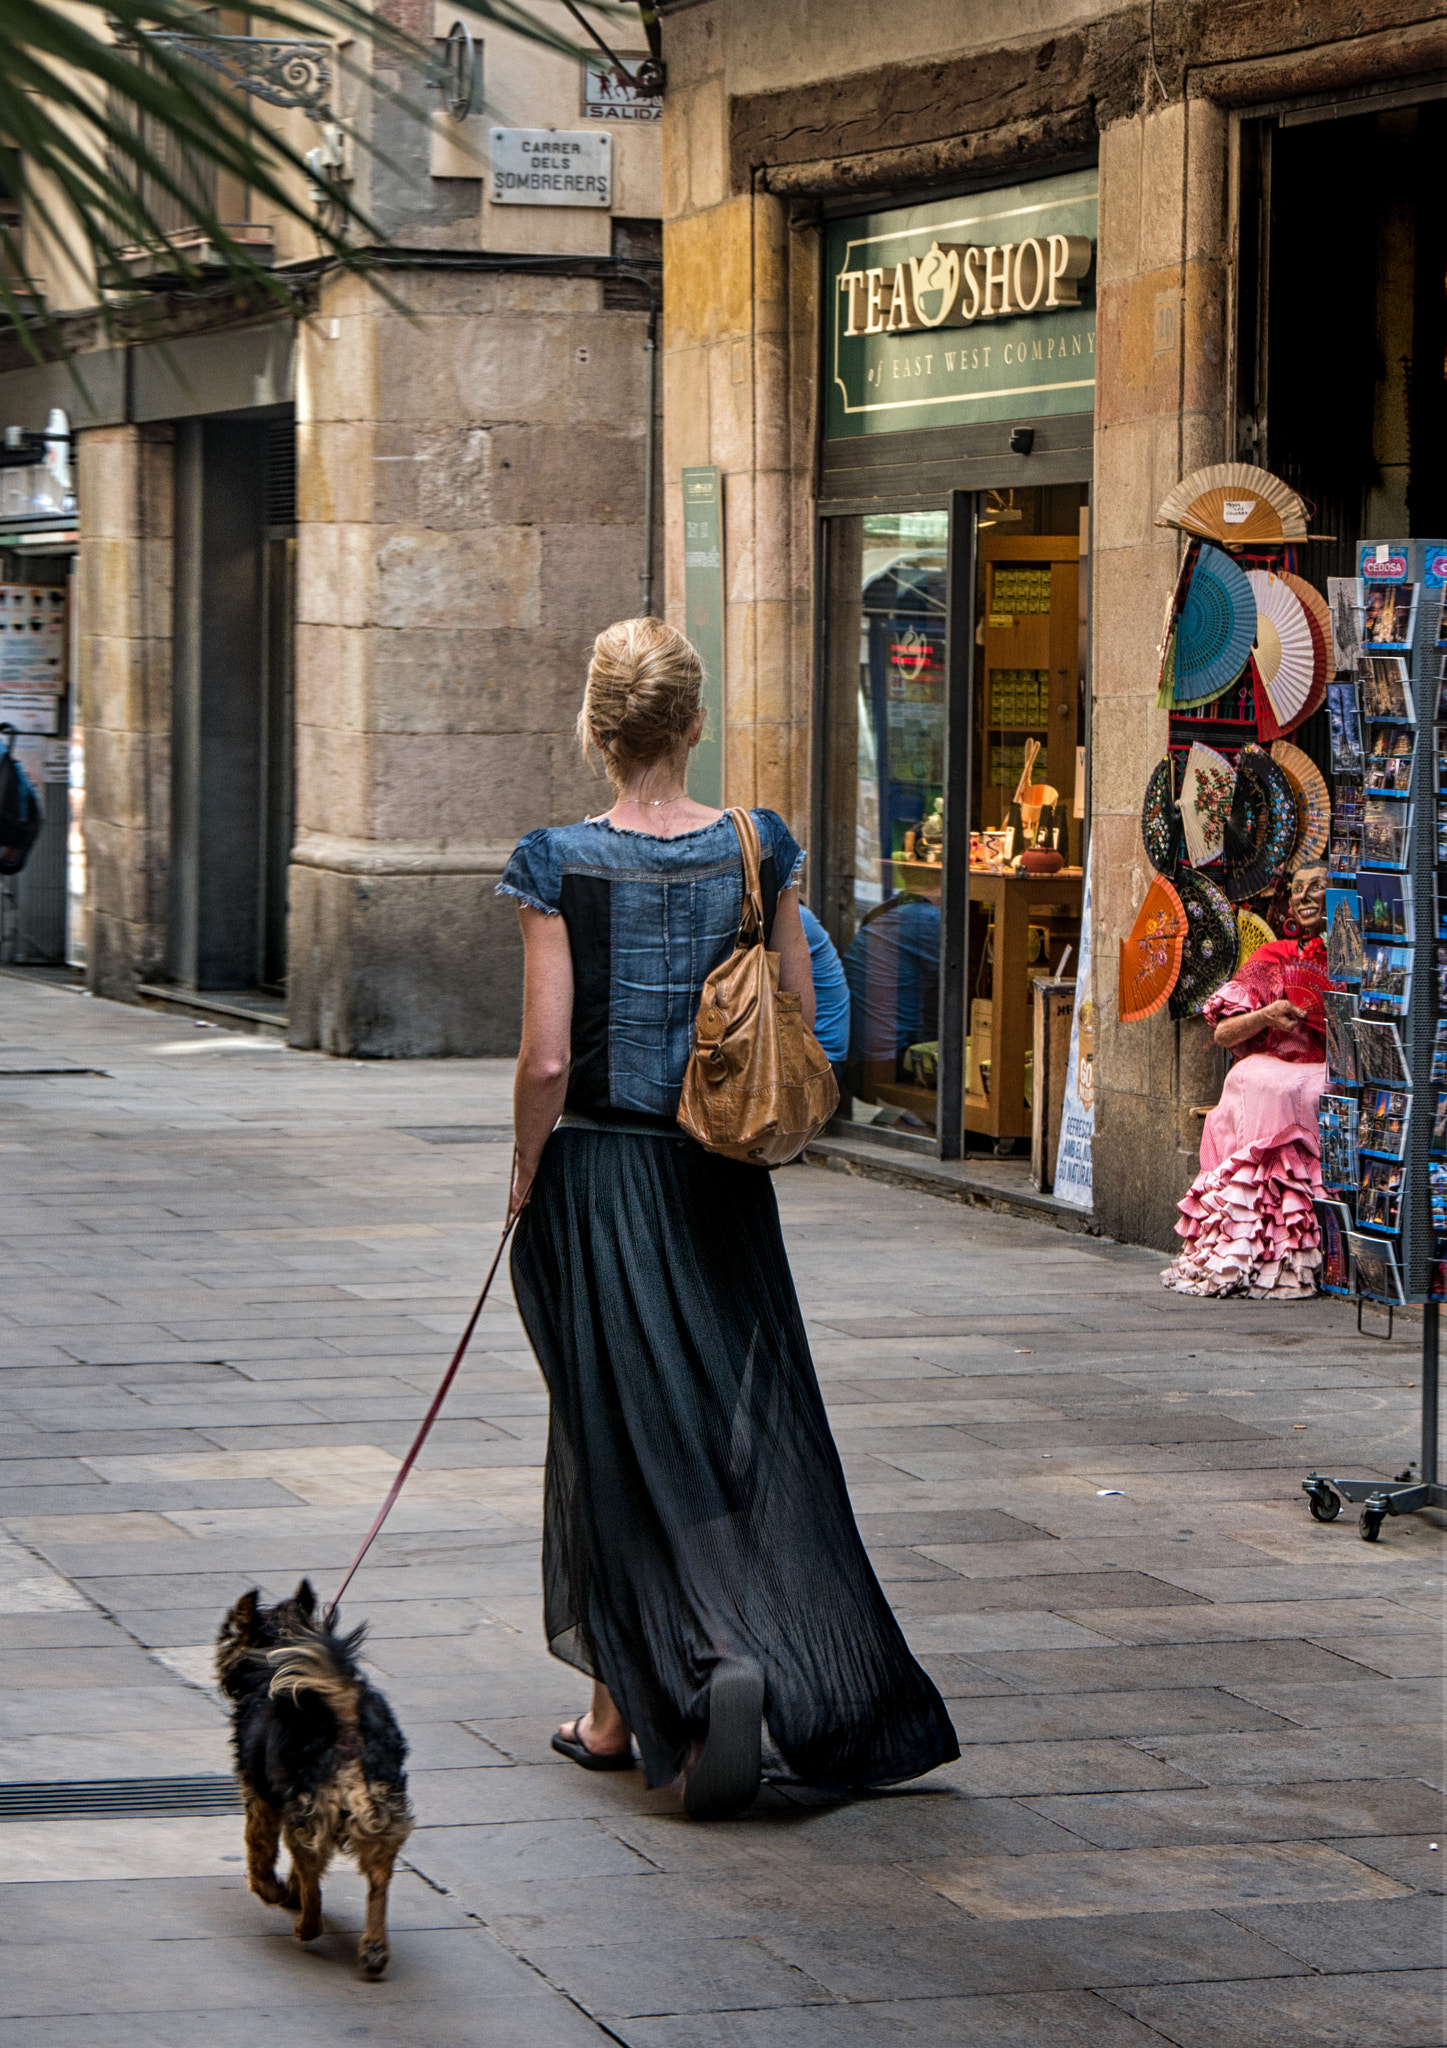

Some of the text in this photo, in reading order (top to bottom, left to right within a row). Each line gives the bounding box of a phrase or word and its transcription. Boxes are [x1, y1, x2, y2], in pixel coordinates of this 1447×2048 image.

[521, 141, 581, 155] CARRER
[531, 157, 571, 170] DELS
[494, 172, 608, 193] SOMBRERERS
[841, 233, 1070, 337] TEA SHOP
[868, 332, 1096, 387] of EAST WEST COMPANY
[1366, 562, 1402, 572] CEDOSA
[1080, 1057, 1093, 1088] GO
